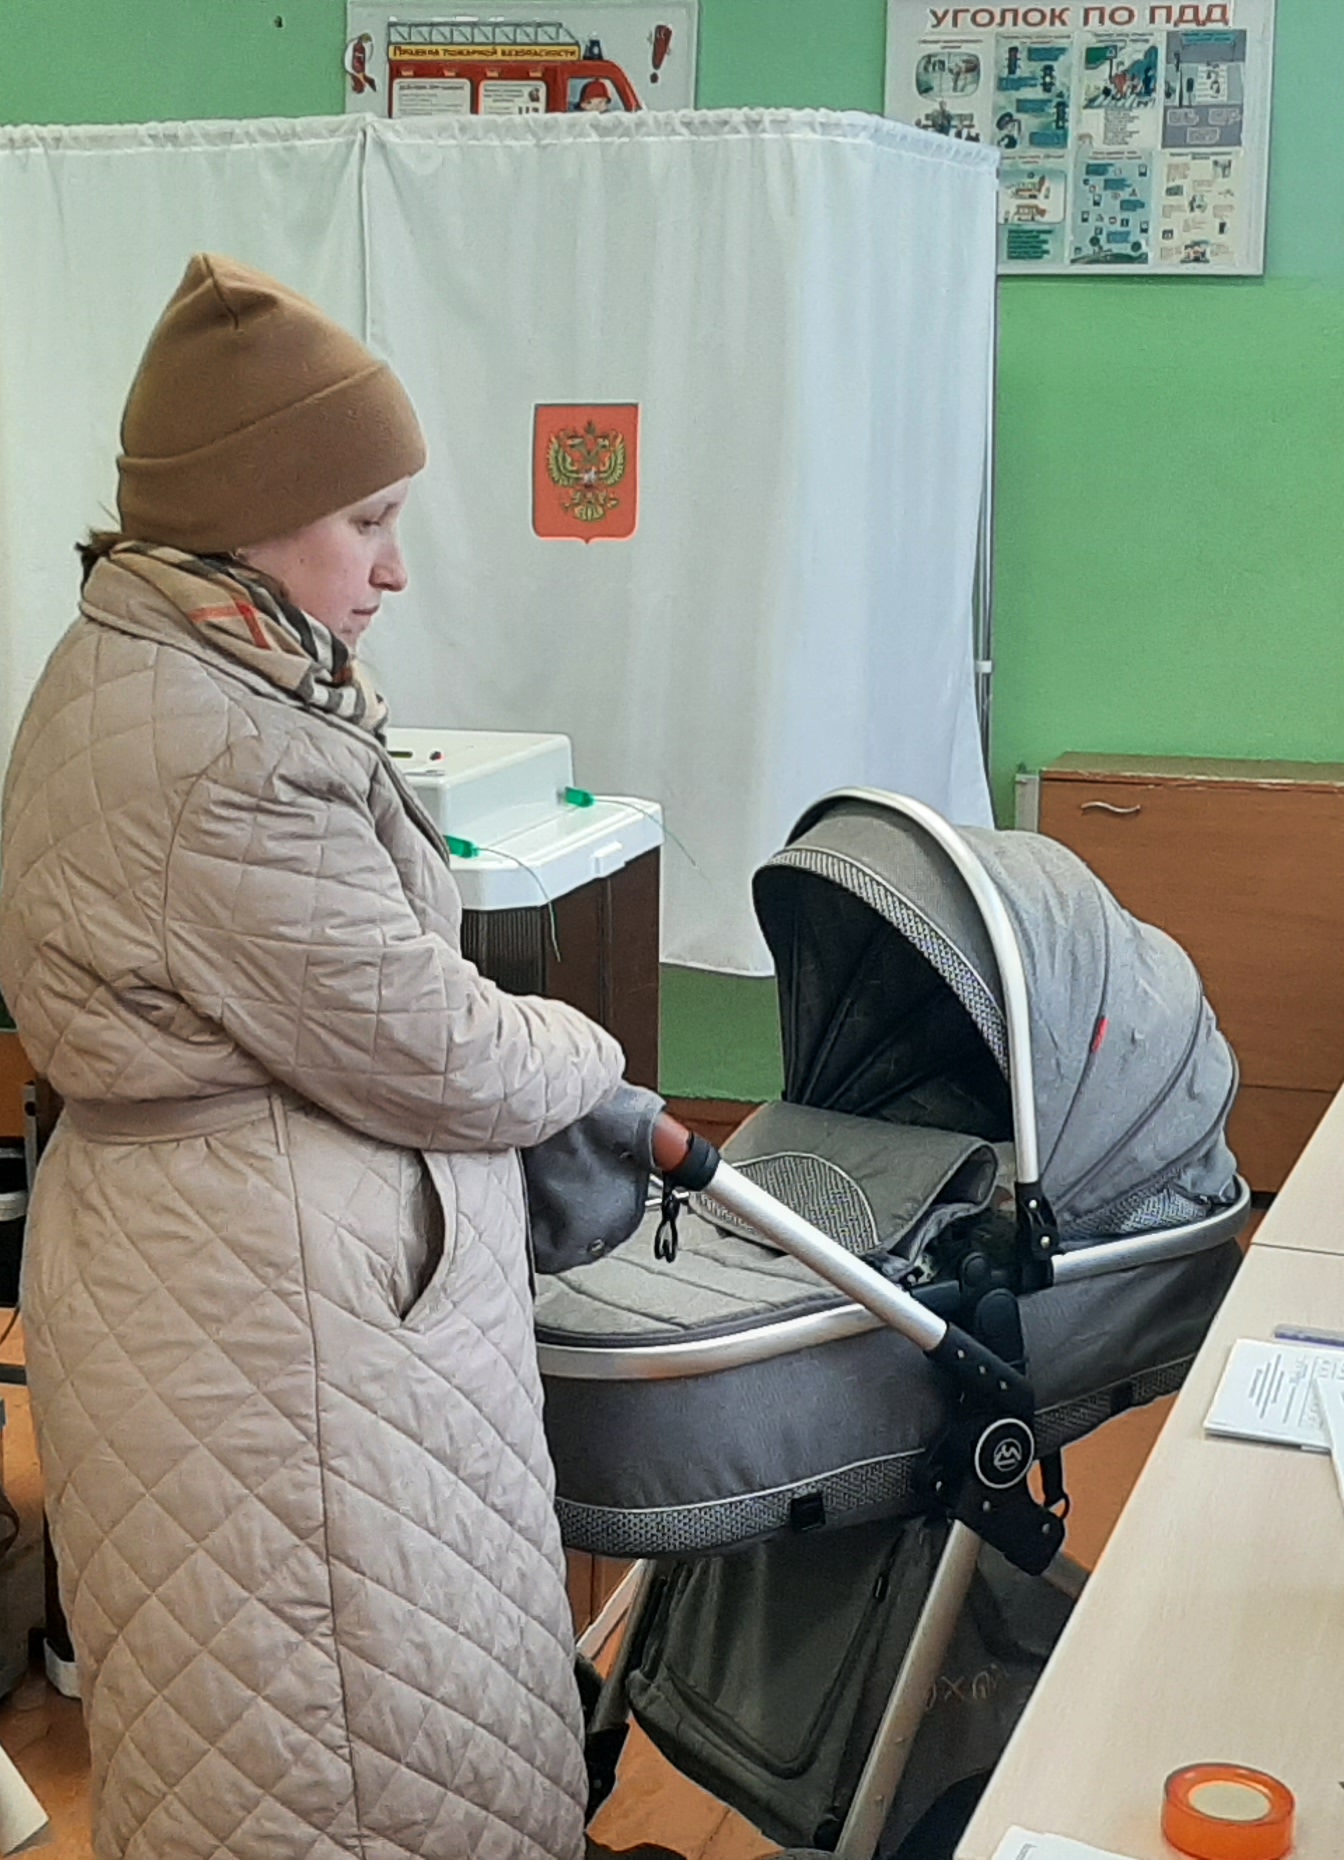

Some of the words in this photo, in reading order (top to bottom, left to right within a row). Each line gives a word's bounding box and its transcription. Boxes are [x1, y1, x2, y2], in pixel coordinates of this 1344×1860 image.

[929, 7, 1070, 29] УГОЛОК
[1083, 6, 1135, 27] ПО
[1149, 3, 1230, 27] ПДД
